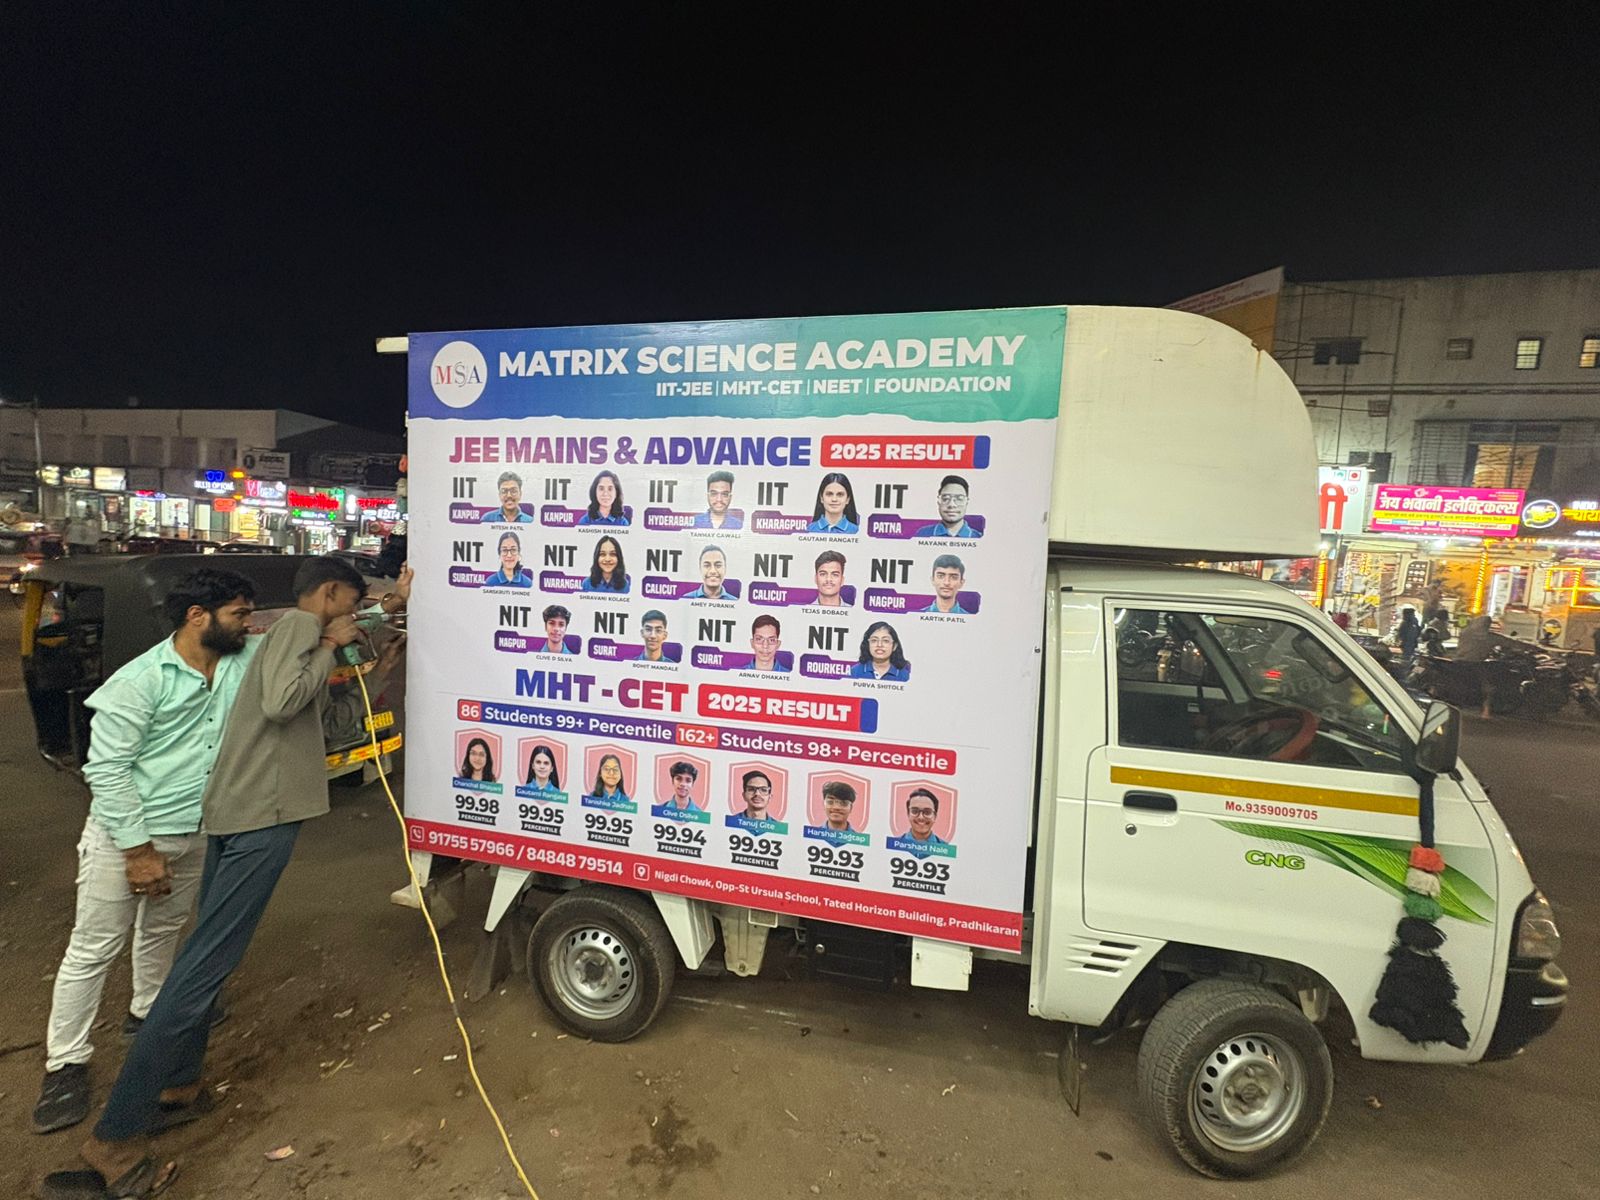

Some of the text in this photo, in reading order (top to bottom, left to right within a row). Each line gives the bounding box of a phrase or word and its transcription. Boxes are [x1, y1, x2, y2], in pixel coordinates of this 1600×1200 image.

[499, 335, 1026, 377] MATRIX SCIENCE ACADEMY
[434, 362, 483, 387] MSA
[656, 376, 1011, 397] IIT-JEE MHT-CET NEET FOUNDATION
[449, 436, 811, 466] JEE MAINS & ADVANCE
[830, 443, 965, 461] 2025 RESULT
[453, 477, 477, 498] IIT
[545, 478, 571, 500] IIT
[649, 480, 678, 503] IIT
[757, 482, 789, 506] IIT
[874, 484, 908, 509] IIT
[452, 509, 480, 520] KANPUR
[1402, 495, 1442, 511] भवानी
[1444, 496, 1520, 515] इलेक्ट्रिकल्स
[544, 512, 574, 523] KANPUR
[648, 515, 695, 527] HYDERABAD
[756, 518, 807, 530] KHARAGPUR
[873, 521, 901, 534] PATNA
[453, 541, 484, 563] NIT
[544, 544, 578, 568] NIT
[646, 549, 682, 572] NIT
[753, 553, 793, 578] NIT
[870, 558, 913, 584] NIT
[452, 572, 486, 584] SURATKAL
[543, 577, 583, 590] WARANGAL
[645, 583, 677, 595] CALICUT
[752, 588, 787, 601] CALICUT
[869, 595, 906, 609] NAGPUR
[499, 605, 531, 627] NIT
[594, 611, 629, 635] NIT
[920, 615, 945, 623] KARTIK
[698, 618, 736, 643] NIT
[808, 625, 849, 651] NIT
[498, 637, 527, 649] NAGPUR
[593, 644, 618, 657] SURAT
[697, 653, 723, 666] SURAT
[806, 662, 851, 676] ROURKELA
[761, 673, 790, 681] DHAKATE
[853, 681, 905, 691] PURVA SHITOLE
[708, 692, 852, 722] 2025 RESULT
[461, 704, 949, 770] 86 Students 99+ Percentile 162+ Students 98+ Percentile
[455, 794, 499, 814] 99.98
[519, 803, 564, 824] 99.95
[1225, 801, 1318, 820] Mo.9359009705
[461, 814, 493, 823] PERCENTILE
[524, 824, 558, 833] PERCENTILE
[585, 813, 633, 834] 99.95
[738, 819, 758, 828] Tanuj
[591, 834, 626, 844] PERCENTILE
[653, 824, 706, 845] 99.94
[807, 828, 865, 842] Harshal Jagtap
[429, 831, 468, 850] 91755
[470, 839, 514, 857] 57966
[527, 847, 576, 867] 84848
[578, 855, 623, 875] 79514
[661, 844, 698, 855] PERCENTILE
[729, 835, 782, 856] 99.93
[894, 840, 927, 851] Parshad
[735, 856, 774, 866] PERCENTILE
[807, 846, 864, 868] 99.93
[1245, 850, 1305, 870] CNG
[814, 868, 856, 879] PERCENTILE
[890, 857, 950, 881] 99.93
[897, 880, 941, 891] PERCENTILE
[655, 870, 1019, 937] Nigdi Chowk, Opp-St Ursula School, Tated Horizon Building, Pradhikaran
